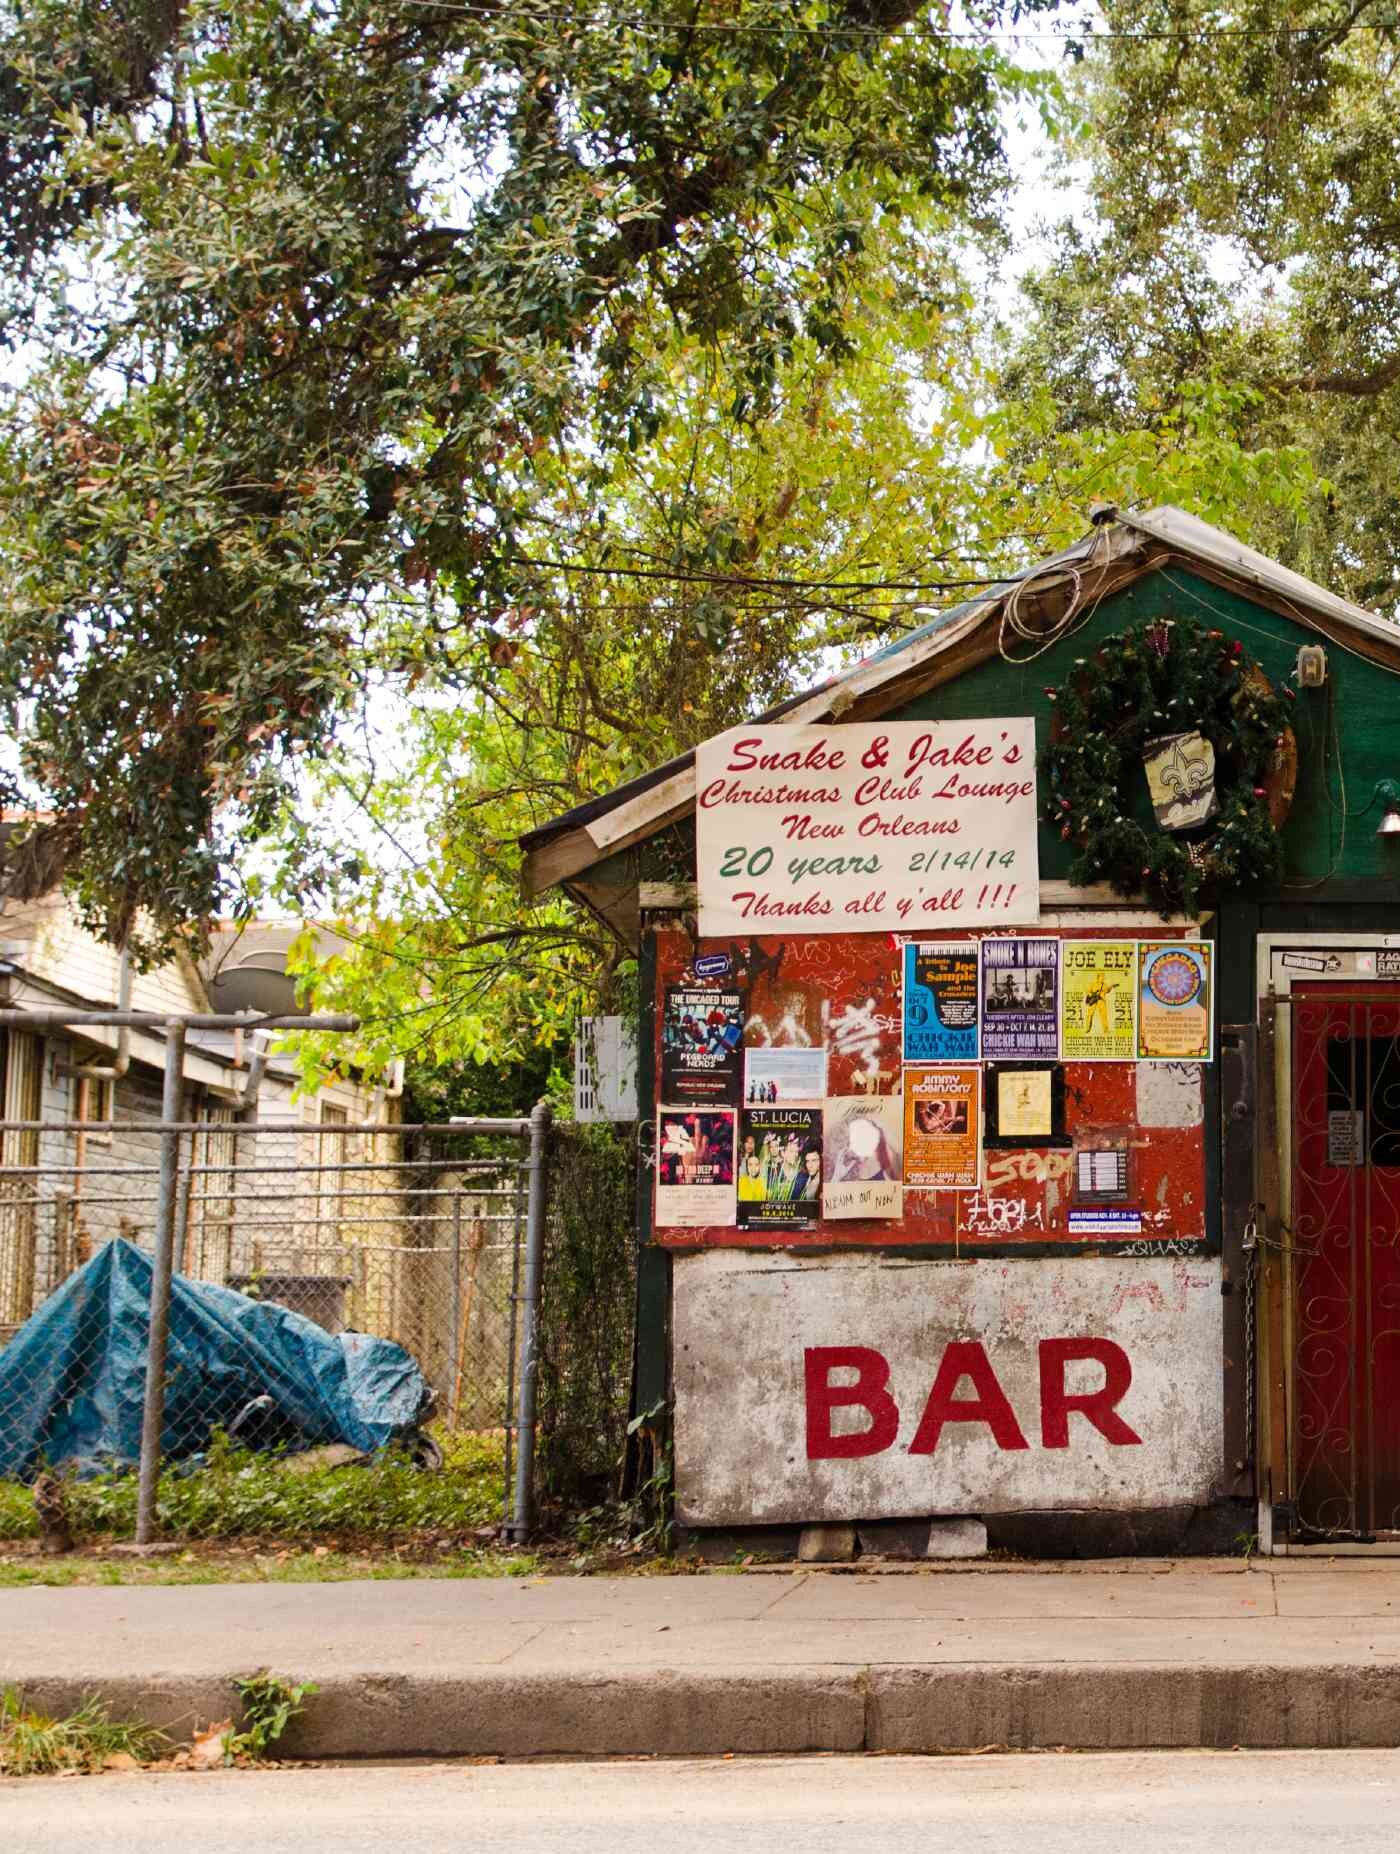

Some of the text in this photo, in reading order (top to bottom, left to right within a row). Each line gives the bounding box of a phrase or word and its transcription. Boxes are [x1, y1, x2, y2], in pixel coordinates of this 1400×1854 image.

[727, 732, 1024, 779] Snake & Jake's
[699, 773, 1034, 808] Christmas Club Lounge
[781, 812, 961, 840] New Orleans
[719, 846, 1015, 883] 20 years 2/14/14
[731, 890, 833, 919] Thanks
[844, 888, 885, 914] all
[897, 887, 963, 919] y'all
[984, 942, 1014, 966] SMOKE
[1027, 942, 1056, 966] BONES
[1065, 951, 1134, 968] JOE ELY
[955, 962, 976, 972] Joe
[926, 971, 976, 983] Sample
[671, 994, 684, 1005] THE
[721, 995, 740, 1006] TOUR
[909, 1005, 928, 1026] 9
[1066, 1009, 1083, 1020] 21
[1115, 1009, 1133, 1020] 21
[984, 1022, 995, 1031] SEP
[1010, 1022, 1021, 1031] OCT
[983, 1034, 1015, 1047] CHICKIE
[1017, 1034, 1036, 1047] WAH
[1037, 1034, 1056, 1047] WAH
[924, 1075, 960, 1085] JIMMY
[751, 1111, 812, 1123] ST. LUCIA
[804, 1336, 1143, 1459] BAR
